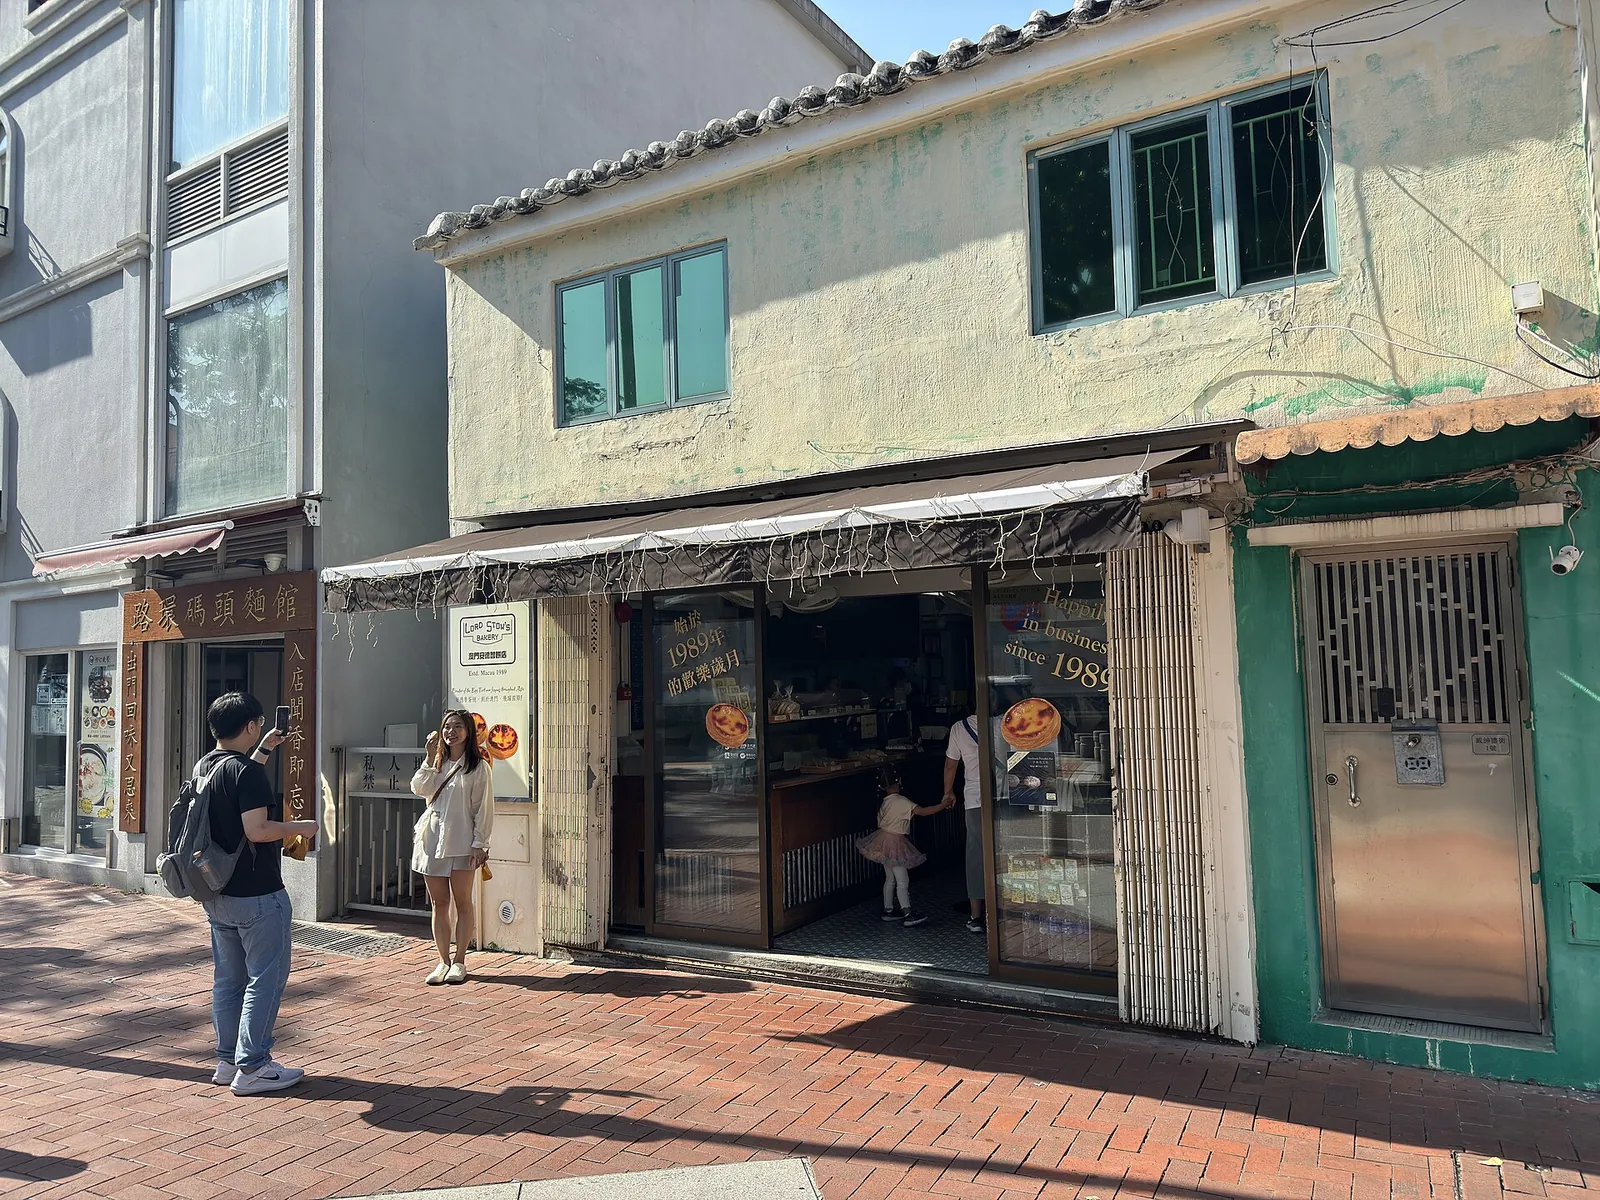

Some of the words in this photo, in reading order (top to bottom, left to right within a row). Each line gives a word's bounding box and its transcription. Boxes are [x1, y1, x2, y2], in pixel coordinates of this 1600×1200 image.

[132, 583, 299, 633] 路環碼頭麵館
[674, 609, 701, 637] 始於
[667, 626, 725, 669] 1989年
[1004, 640, 1046, 665] since
[1022, 613, 1039, 633] in
[1045, 619, 1108, 655] busines
[667, 649, 740, 698] 的歡樂歲月
